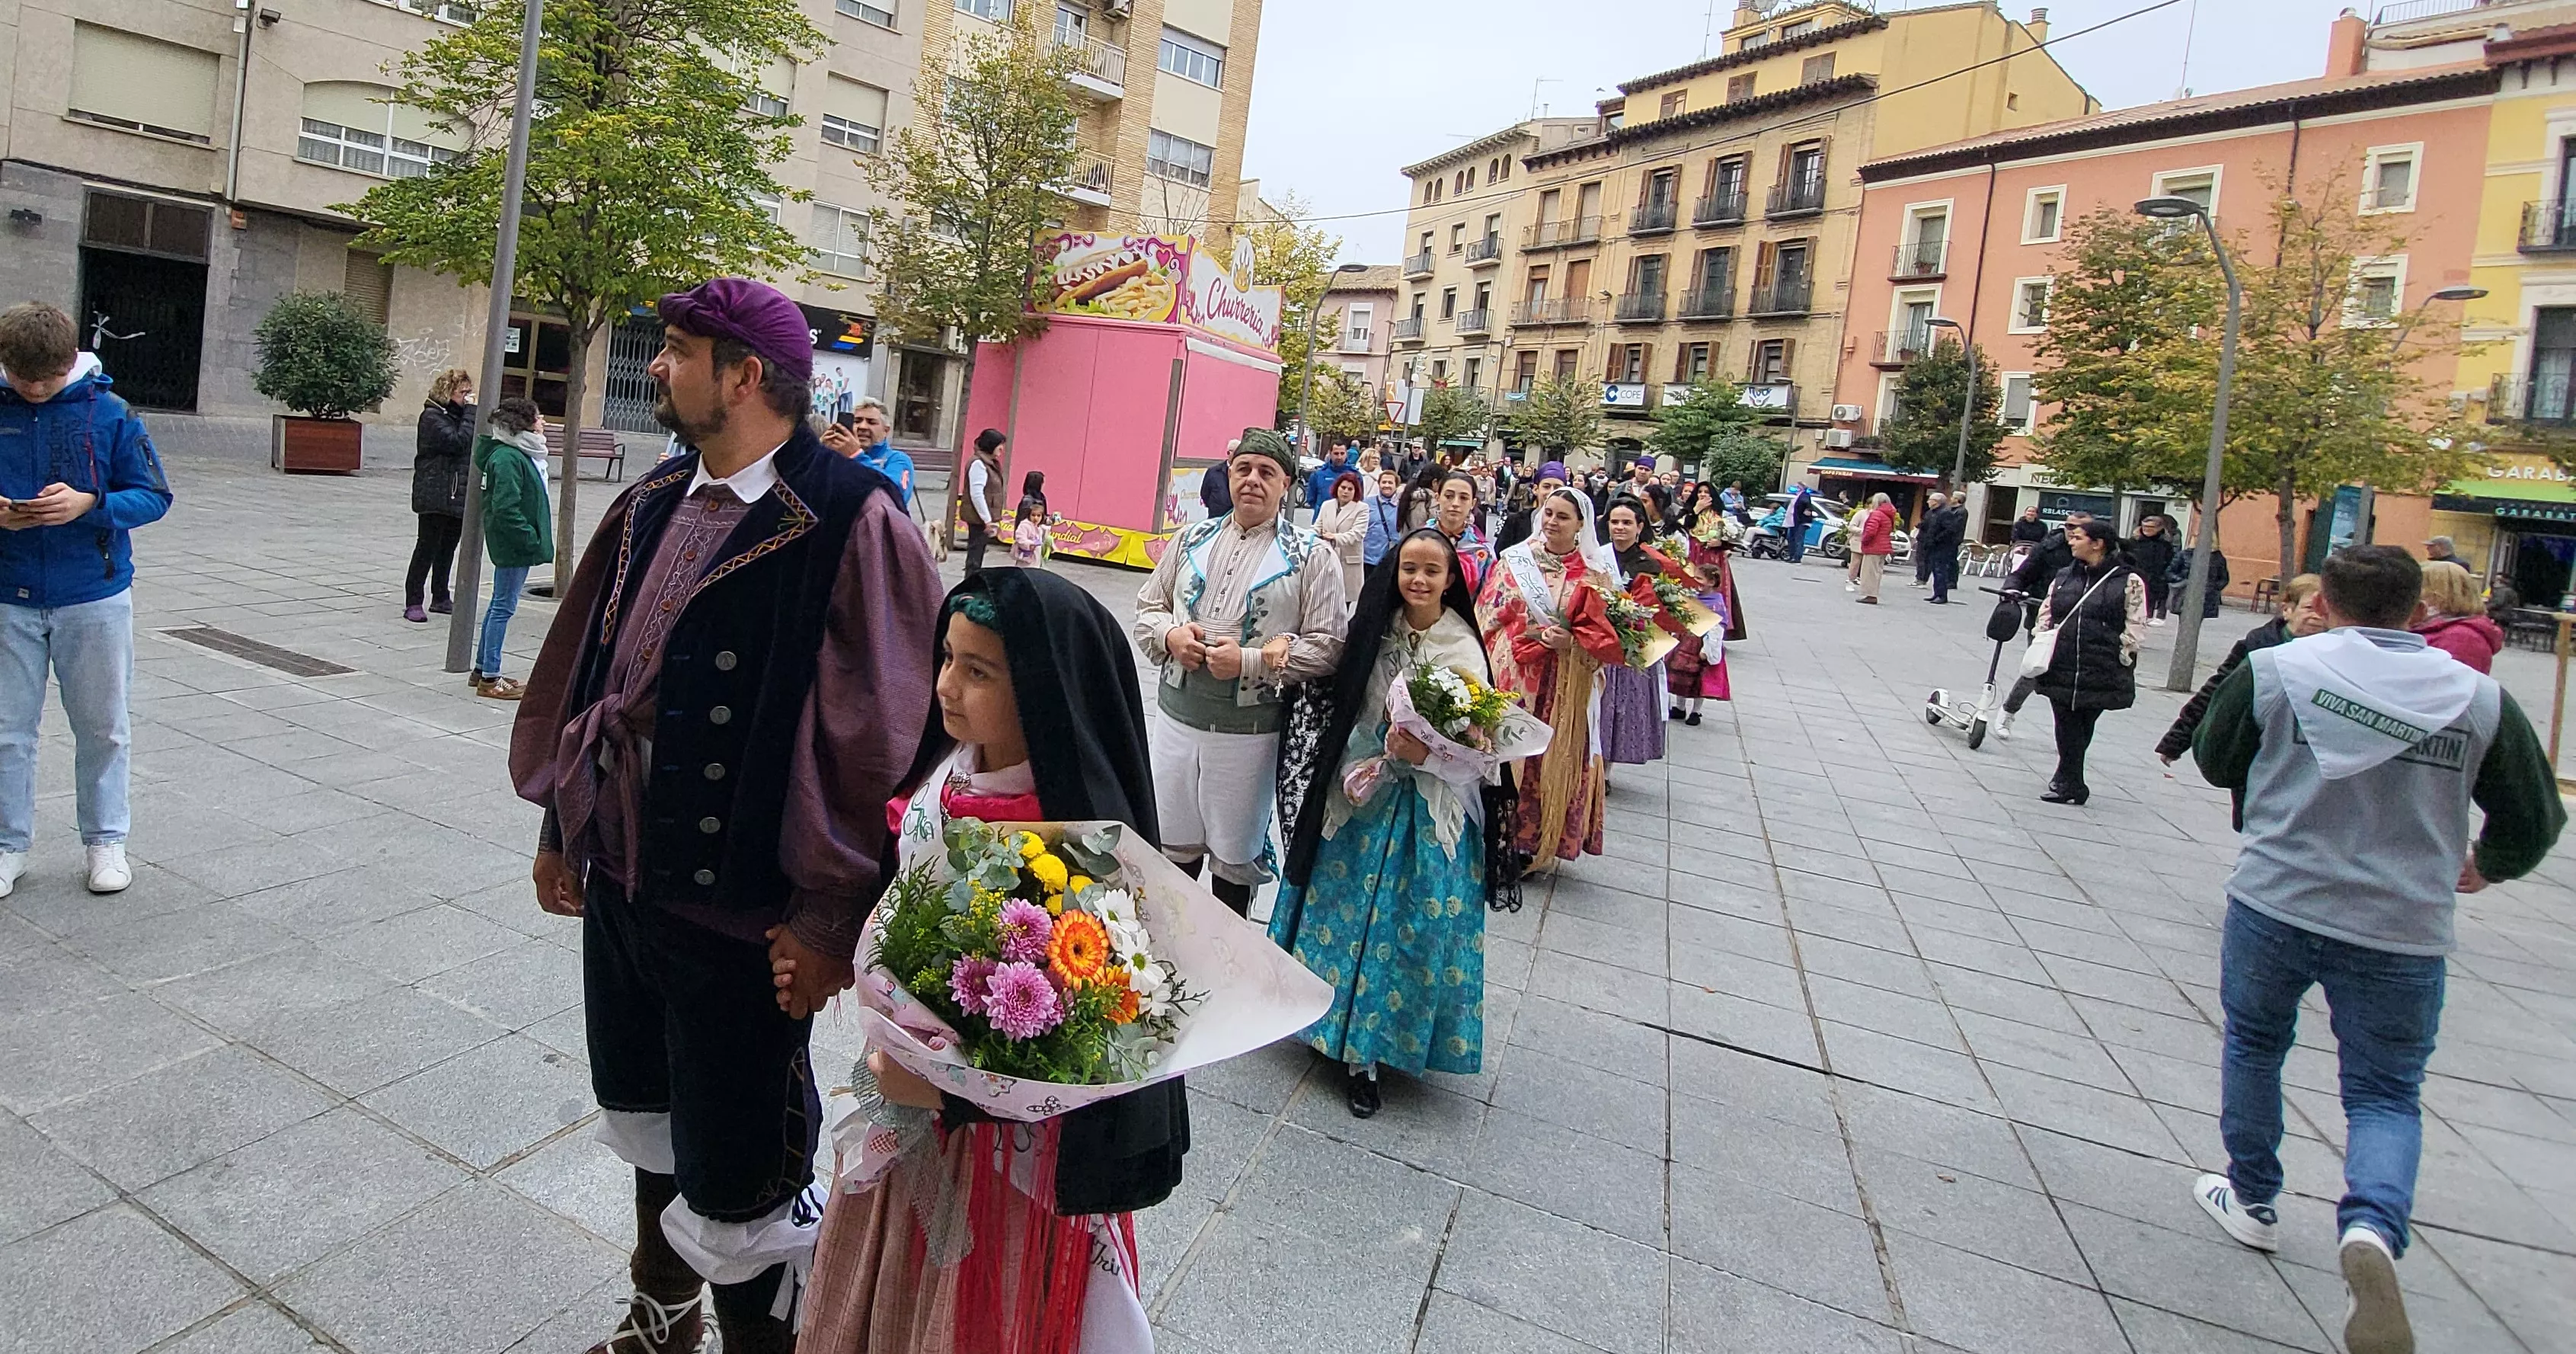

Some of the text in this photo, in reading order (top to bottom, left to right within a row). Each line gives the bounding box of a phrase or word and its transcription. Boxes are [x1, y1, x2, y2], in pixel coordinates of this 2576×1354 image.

[1207, 277, 1264, 334] Churreria
[1620, 389, 1641, 399] COPE
[1050, 530, 1084, 544] undial
[2317, 691, 2427, 744] VIVA SAN MARTIN
